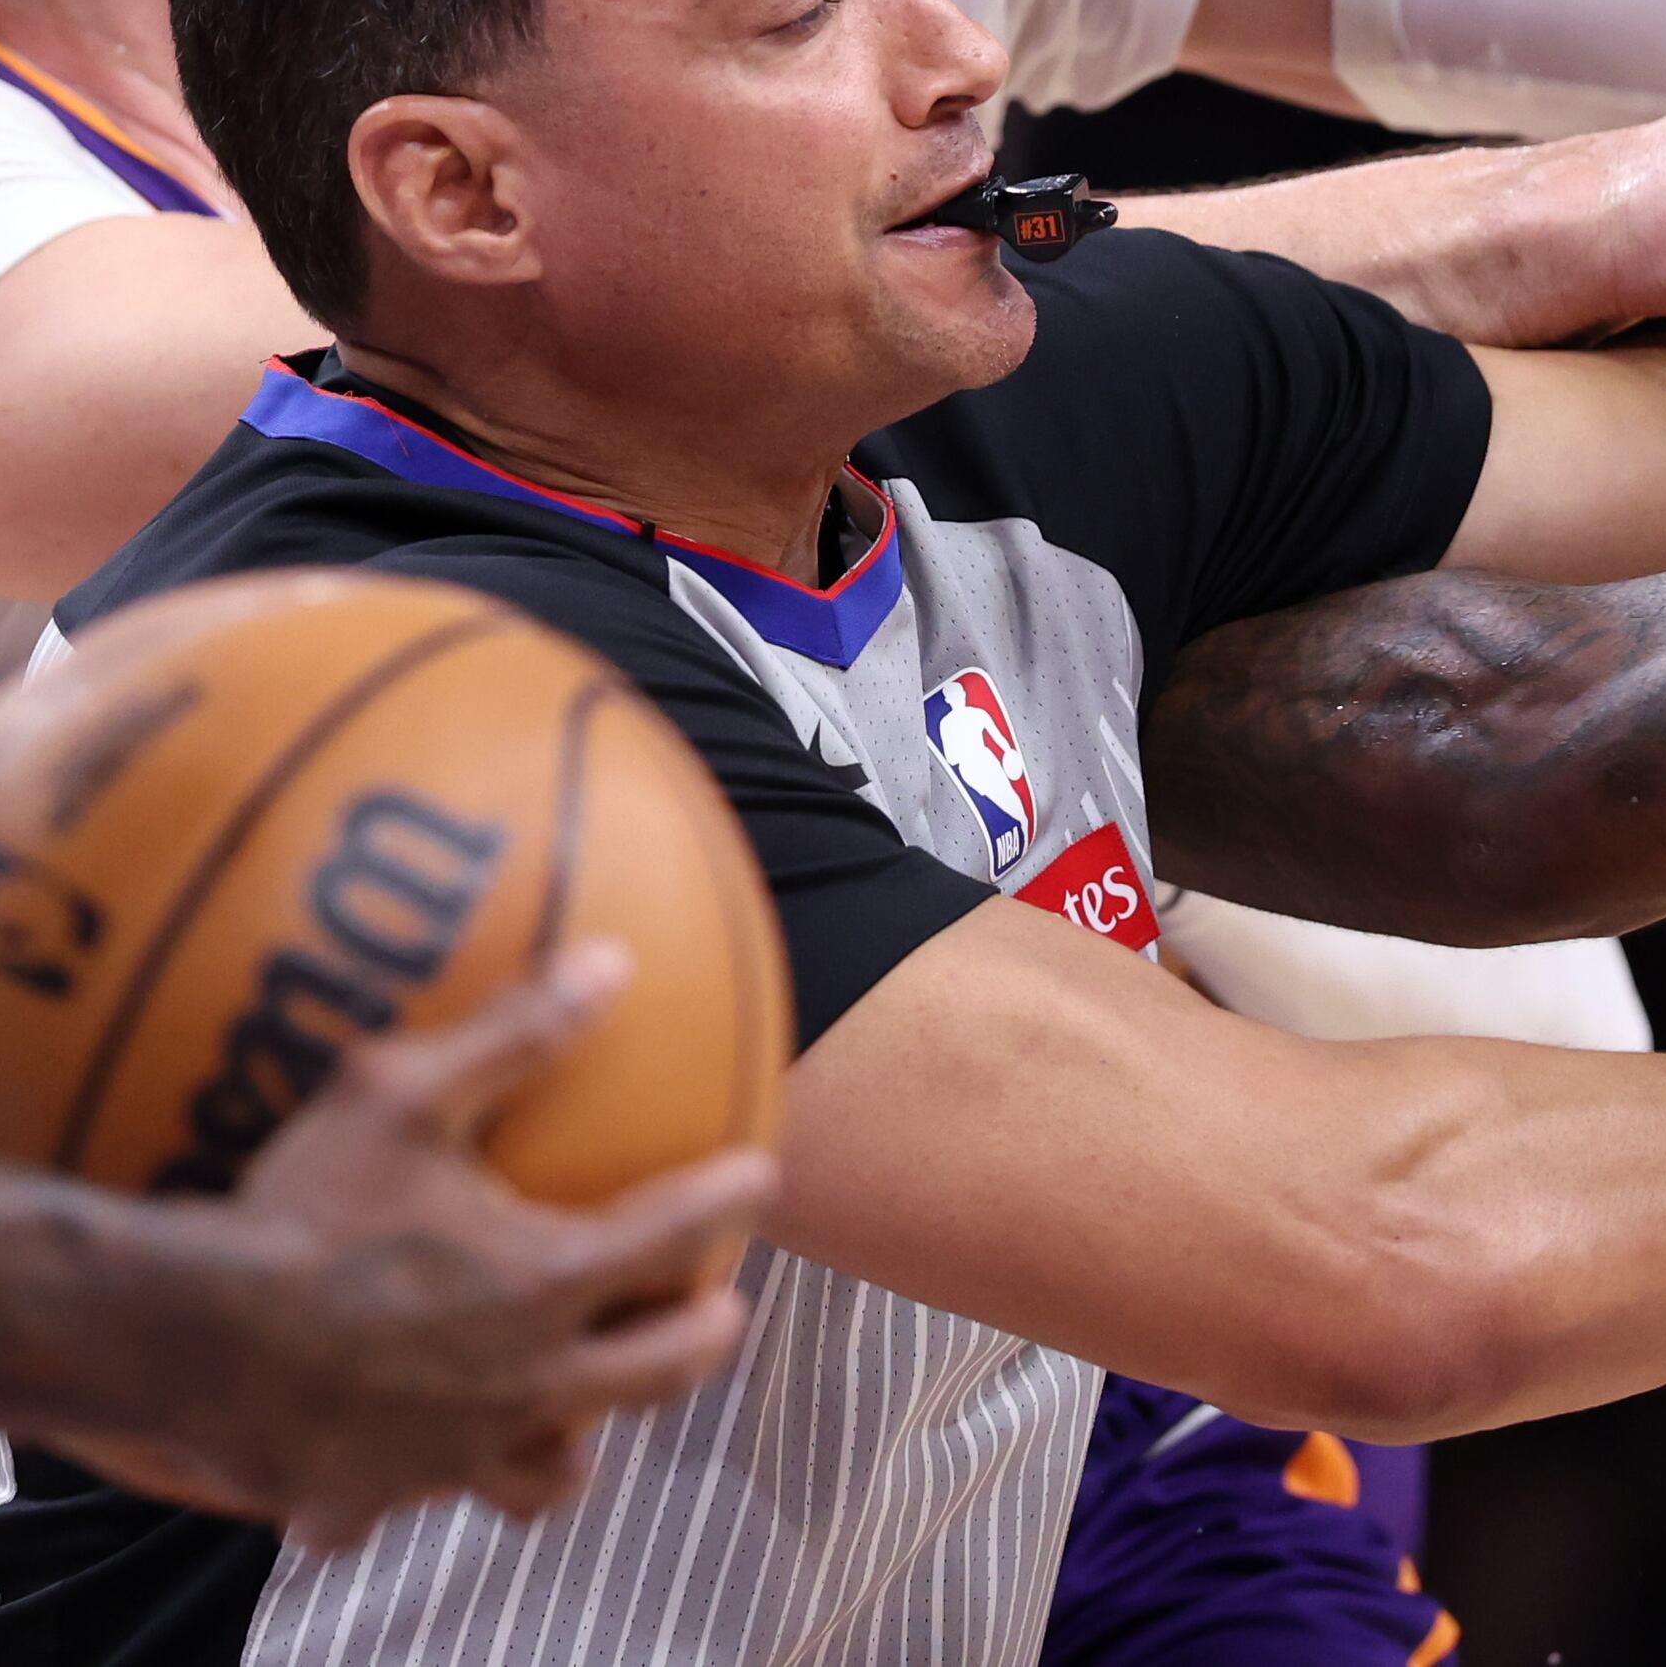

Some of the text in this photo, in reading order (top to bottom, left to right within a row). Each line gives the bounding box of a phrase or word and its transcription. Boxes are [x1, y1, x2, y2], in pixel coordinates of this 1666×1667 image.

[1019, 214, 1058, 240] #31
[996, 825, 1021, 870] NBA
[1055, 864, 1139, 934] tes
